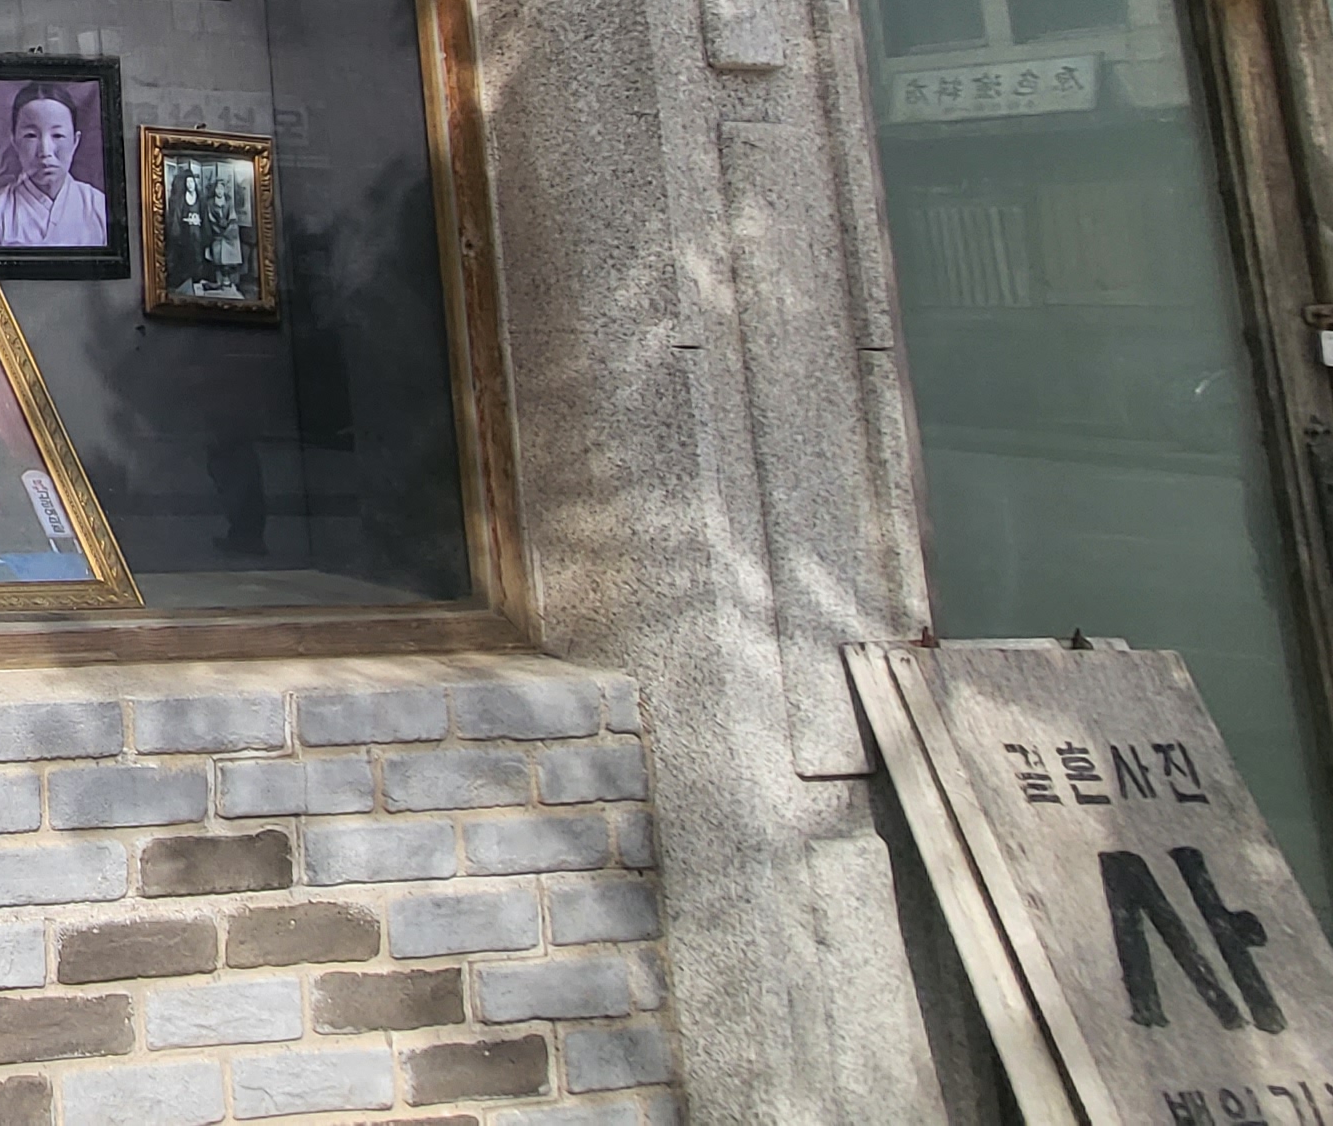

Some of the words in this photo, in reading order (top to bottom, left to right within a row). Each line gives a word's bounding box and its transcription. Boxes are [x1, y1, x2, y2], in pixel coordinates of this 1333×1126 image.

[1003, 739, 1211, 806] 결혼사진
[1097, 845, 1288, 1035] 사
[1162, 1081, 1333, 1126] 백일기
